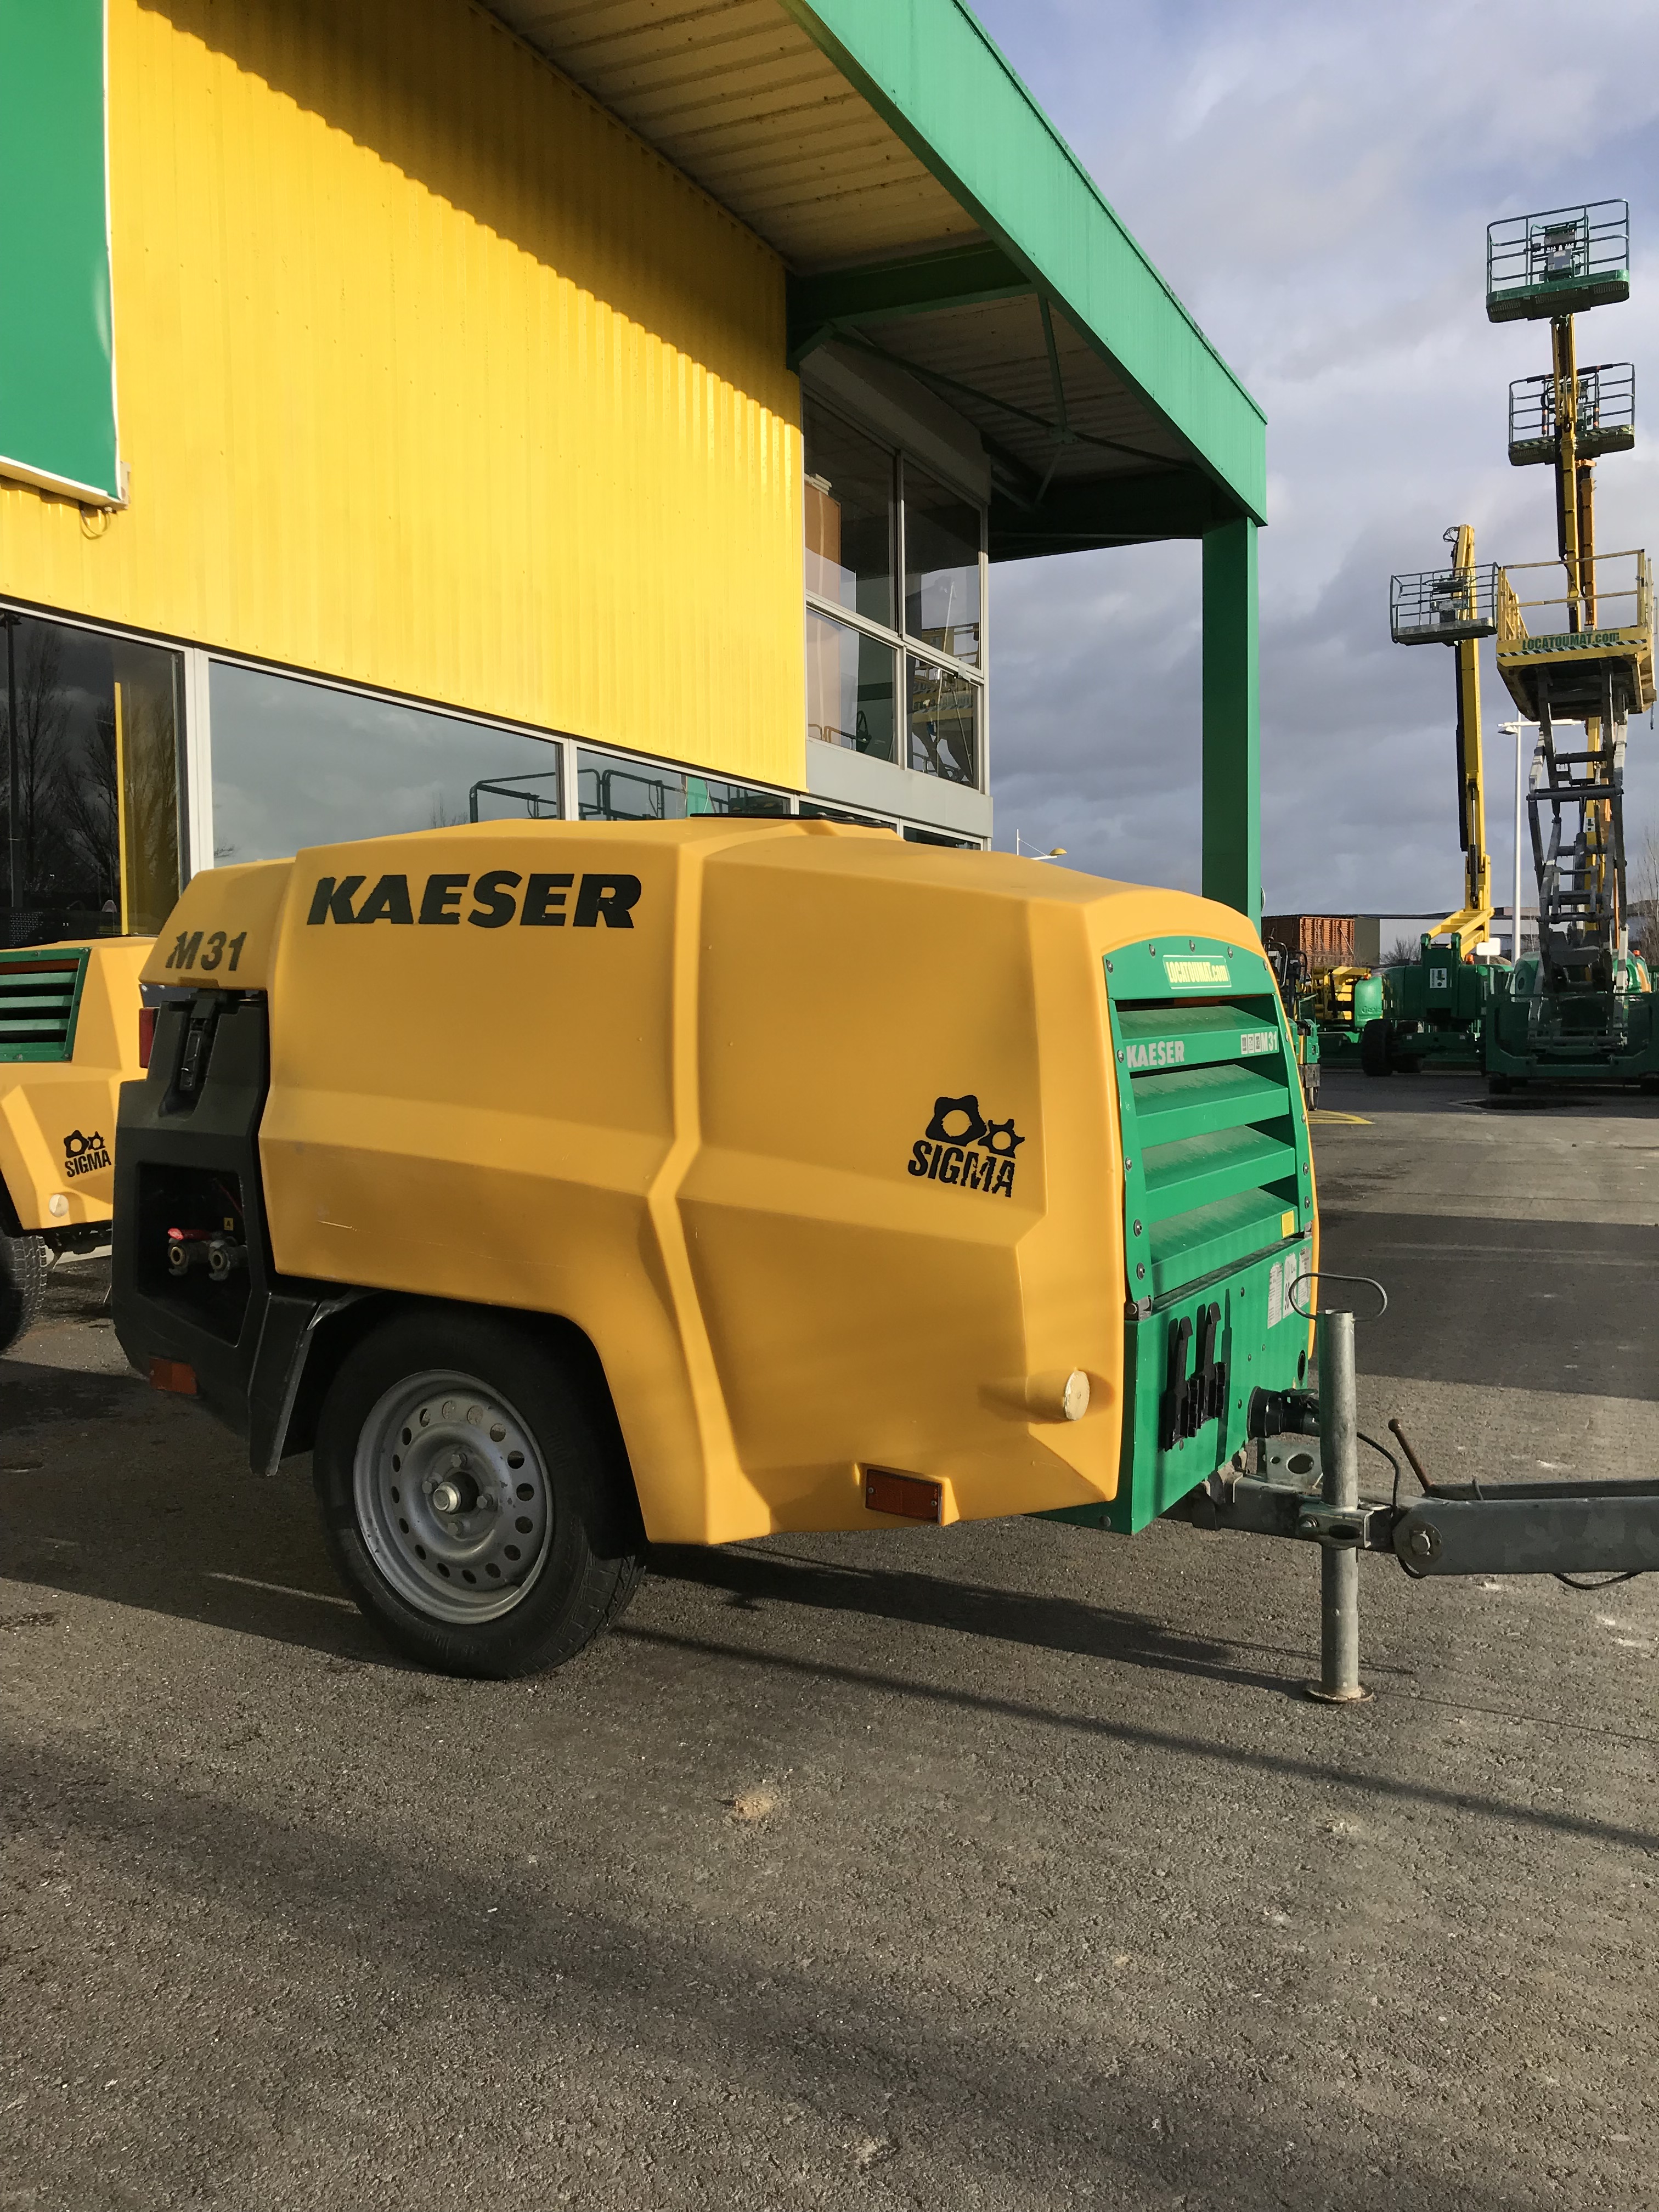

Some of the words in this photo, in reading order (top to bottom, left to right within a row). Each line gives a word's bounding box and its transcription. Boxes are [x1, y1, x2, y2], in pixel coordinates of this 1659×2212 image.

[1522, 632, 1620, 650] LOCATOUMAT.com
[306, 870, 641, 929] KAESER
[1165, 961, 1228, 983] LOCATOUMAT.com
[1126, 1041, 1184, 1068] KAESER
[65, 1149, 111, 1177] SIGMA
[908, 1140, 1015, 1198] SIGMA
